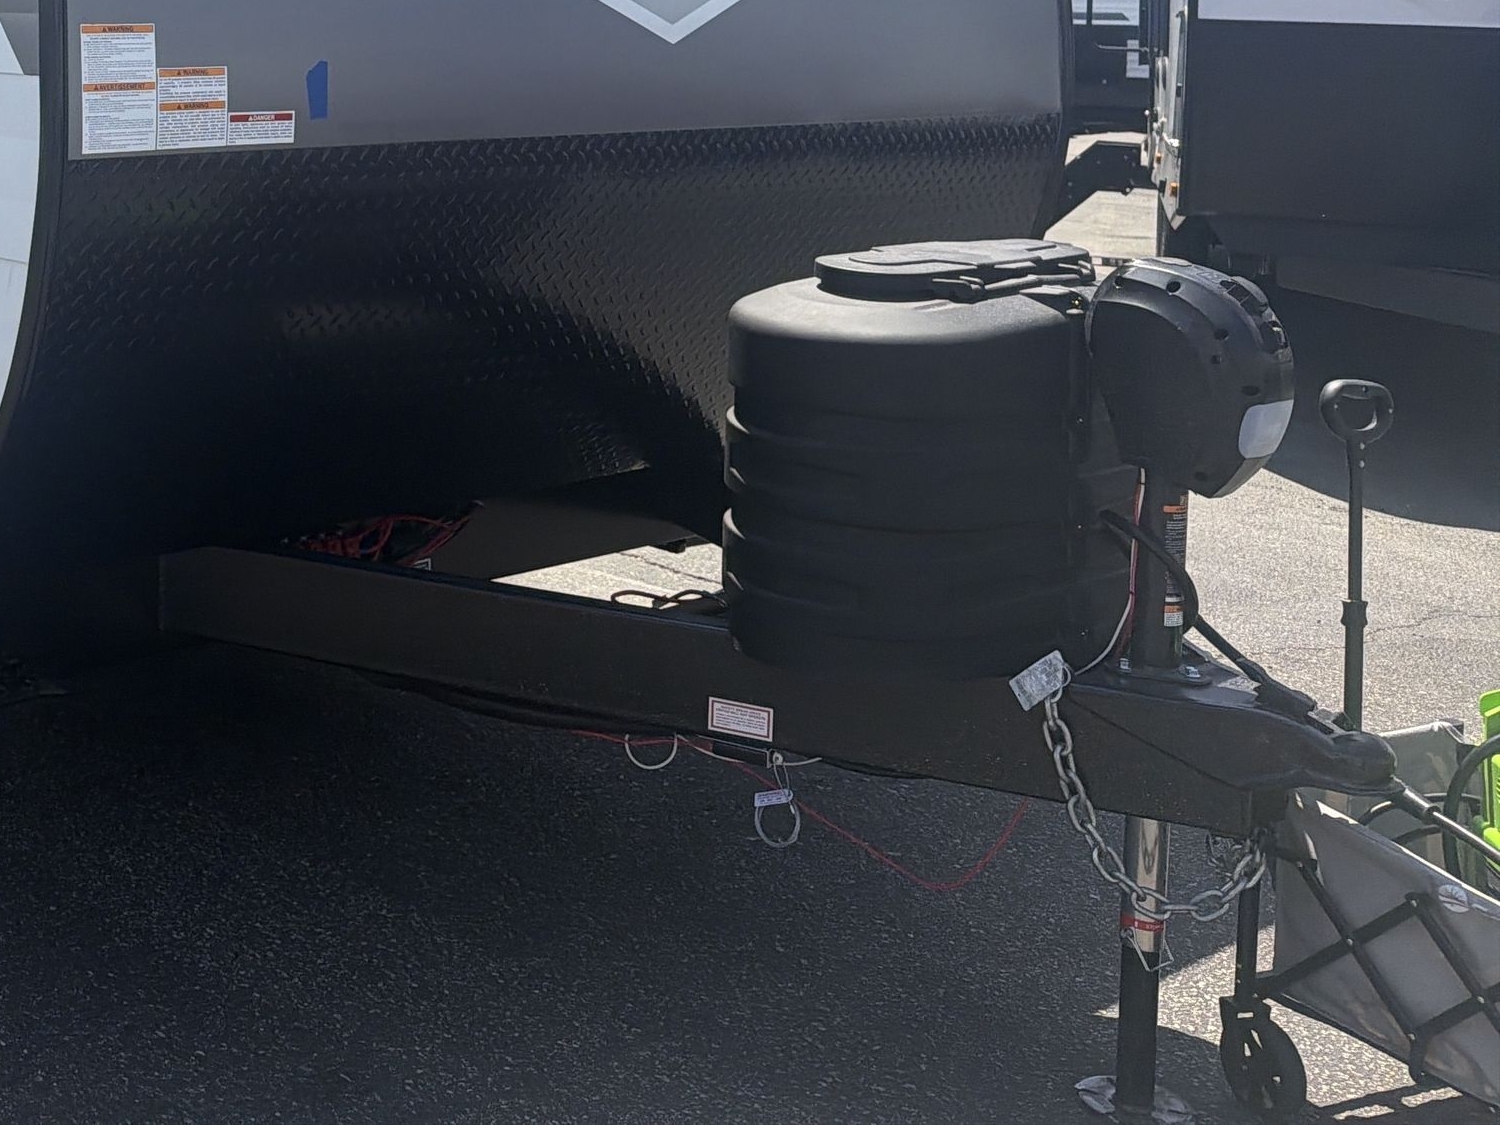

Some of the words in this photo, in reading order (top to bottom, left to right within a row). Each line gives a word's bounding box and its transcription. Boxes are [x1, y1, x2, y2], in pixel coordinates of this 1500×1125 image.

[107, 25, 134, 33] WARNING
[182, 68, 209, 76] WARNING
[99, 82, 145, 91] AVERTISSEMENT
[183, 102, 209, 110] WARNING
[253, 114, 275, 122] DANGER
